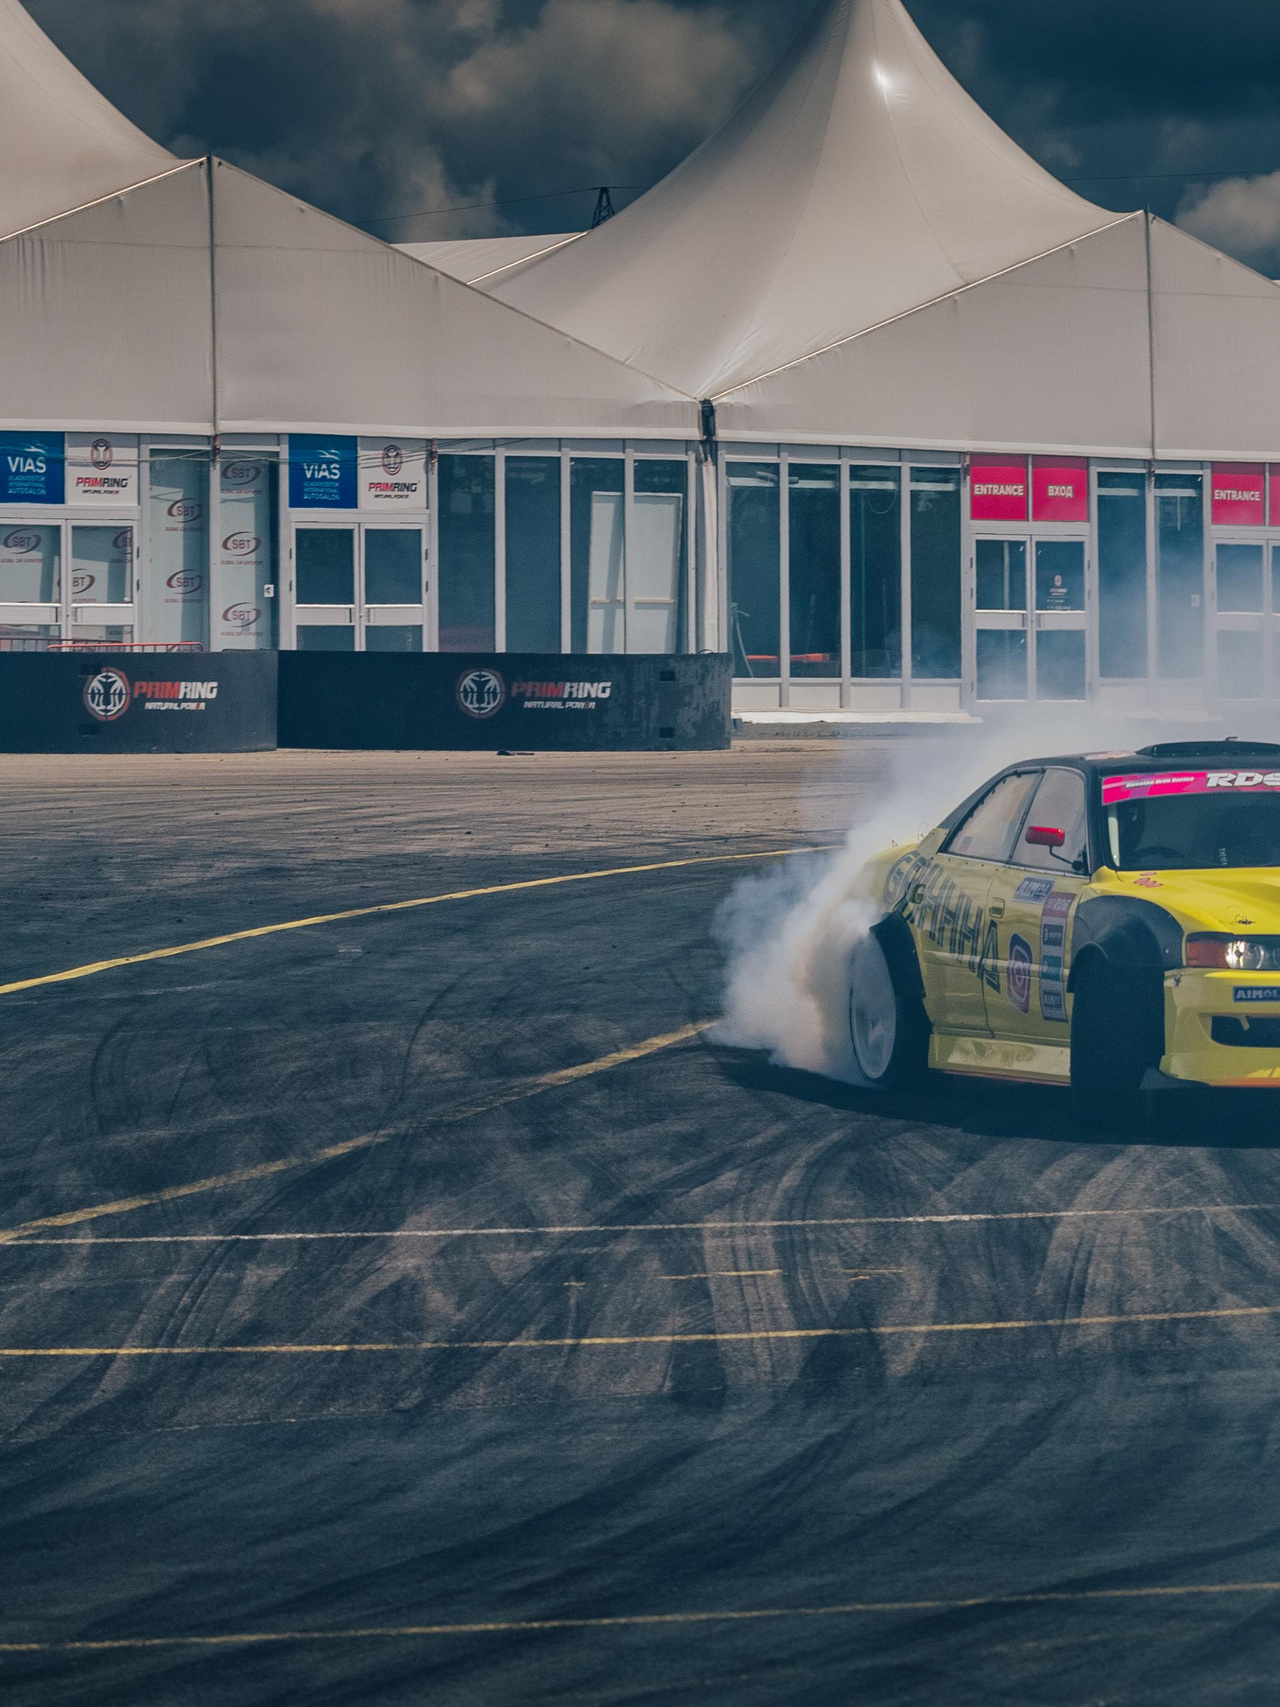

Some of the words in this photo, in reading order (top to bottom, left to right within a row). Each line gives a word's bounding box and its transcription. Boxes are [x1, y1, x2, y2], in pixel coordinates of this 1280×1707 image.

[7, 456, 47, 473] VIAS
[231, 467, 251, 479] SBT
[303, 462, 341, 480] VIAS
[75, 476, 129, 488] PRIMRING
[367, 482, 418, 493] PRIMRING
[973, 484, 1024, 496] ENTRANCE
[1047, 485, 1074, 498] ВХОД
[1213, 489, 1261, 501] ENTRANCE
[176, 505, 195, 516] SBT
[13, 536, 32, 548] SBT
[231, 539, 251, 550] SBT
[72, 576, 86, 587] BT
[176, 576, 195, 587] SBT
[231, 610, 251, 621] SBT
[133, 681, 218, 699] PRIMRING
[511, 681, 612, 698] PRIMRING
[1235, 989, 1280, 999] AIMOL
